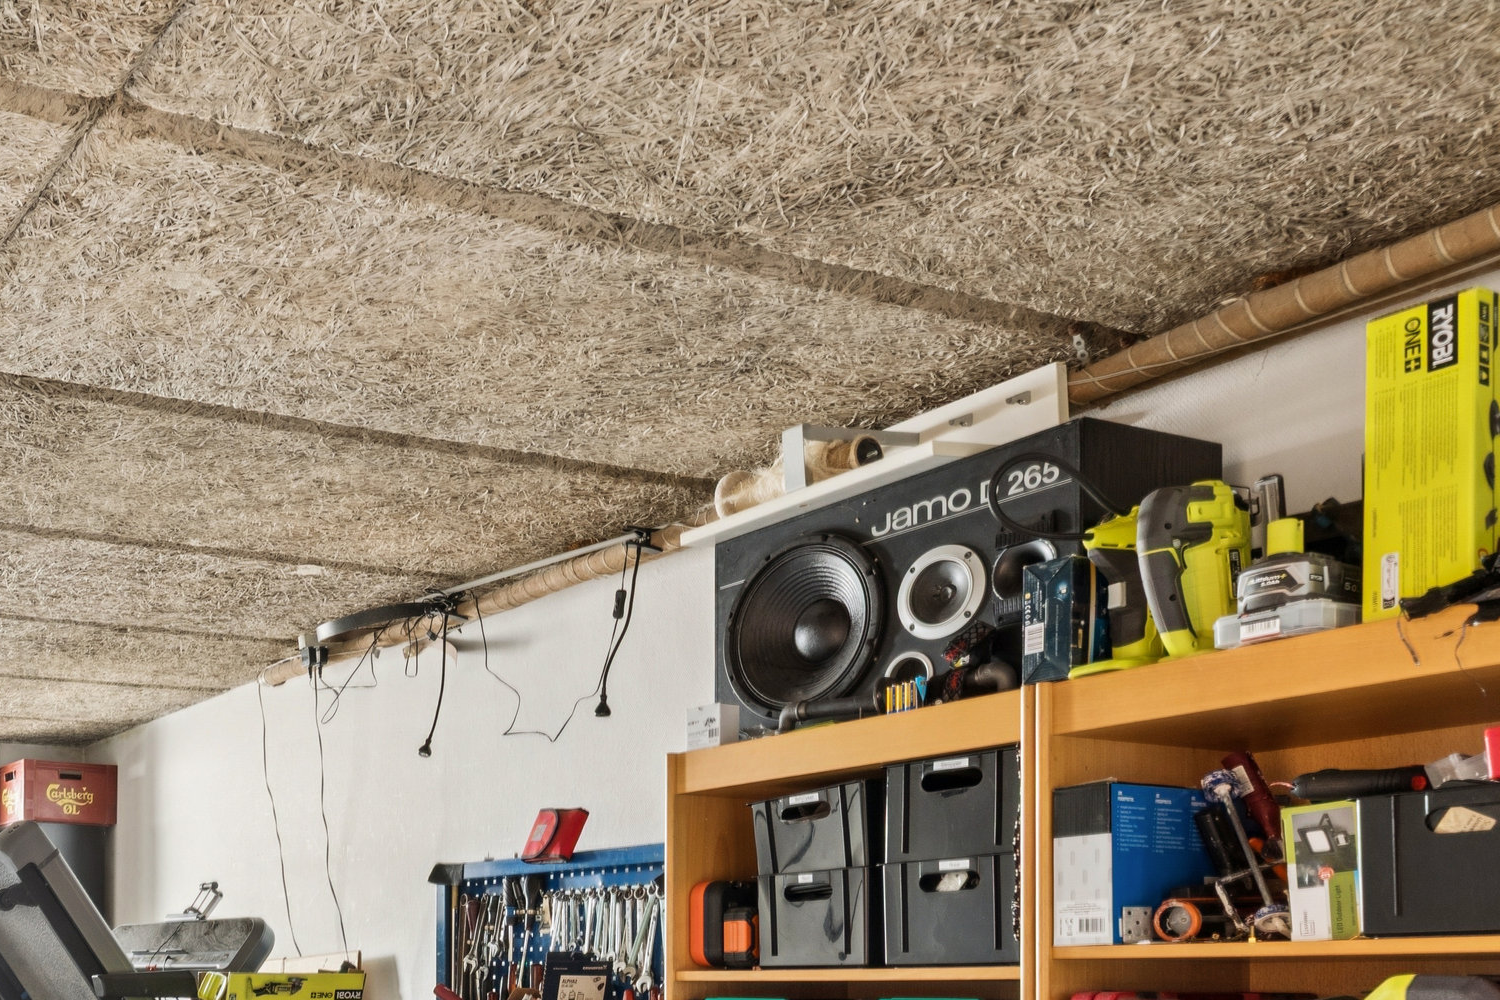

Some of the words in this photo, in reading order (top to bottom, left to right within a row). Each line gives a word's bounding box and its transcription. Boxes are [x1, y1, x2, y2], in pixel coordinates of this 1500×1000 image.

[1432, 303, 1454, 369] RYOBI
[871, 488, 972, 537] Jamo
[1007, 461, 1060, 496] 265
[46, 783, 94, 805] Carlsberg
[63, 804, 80, 815] ØL
[336, 991, 362, 999] RYOBI
